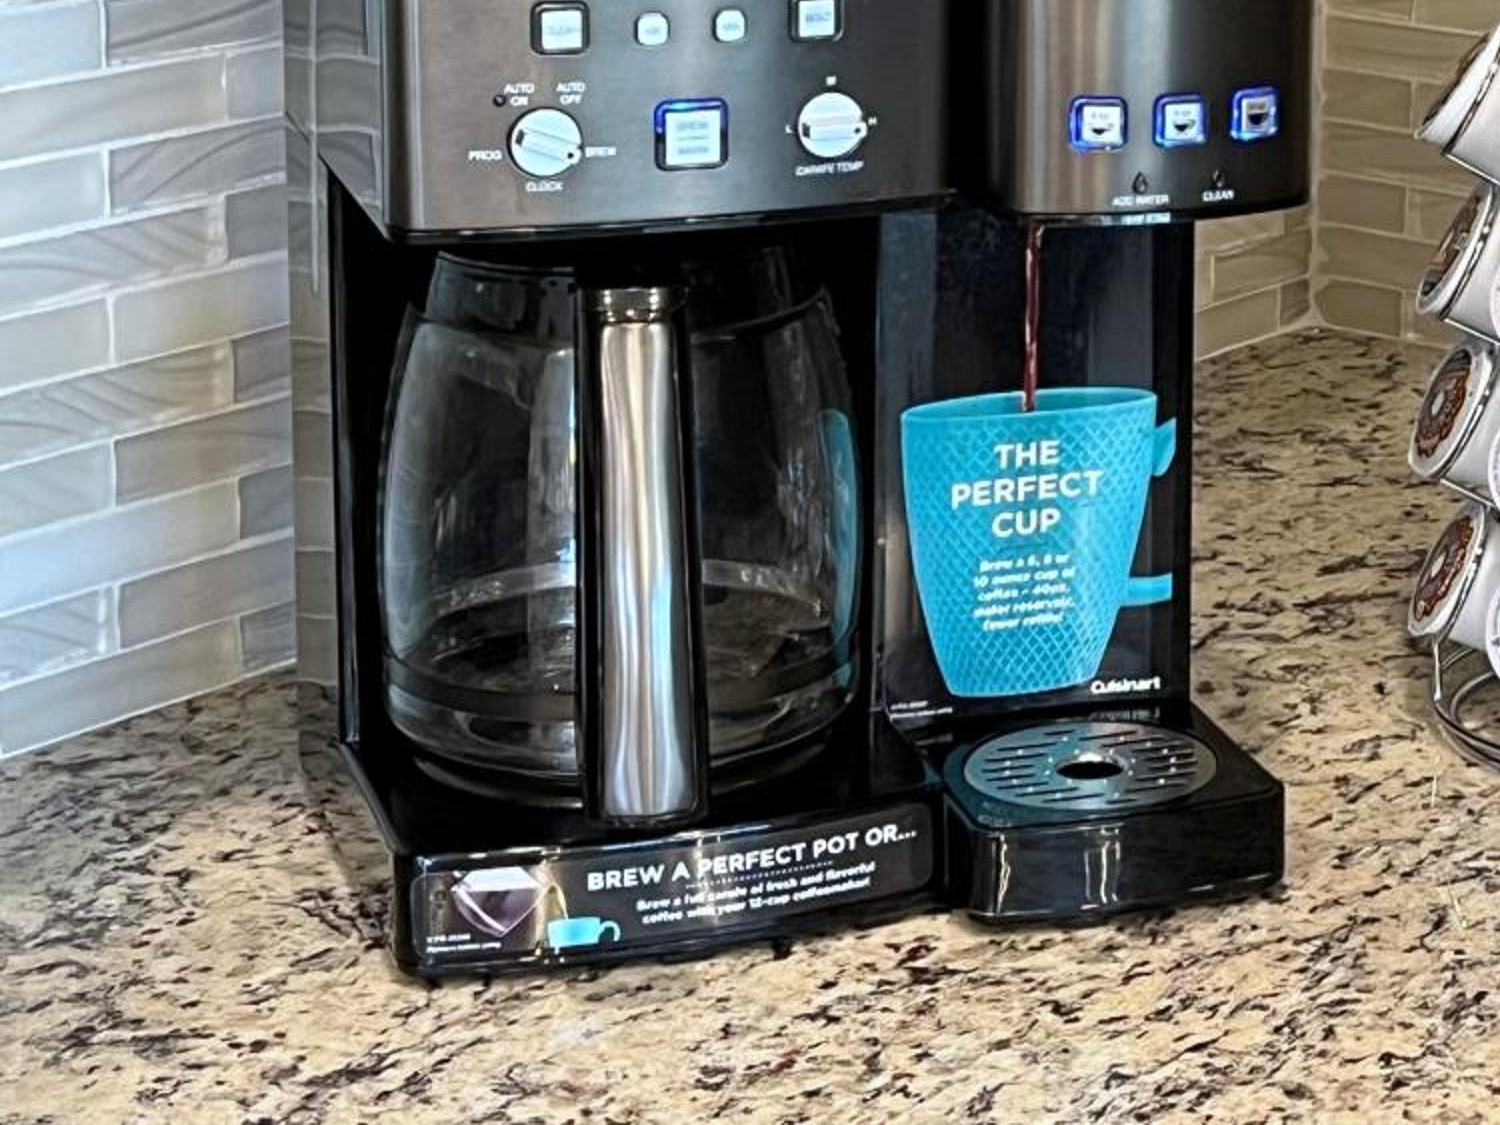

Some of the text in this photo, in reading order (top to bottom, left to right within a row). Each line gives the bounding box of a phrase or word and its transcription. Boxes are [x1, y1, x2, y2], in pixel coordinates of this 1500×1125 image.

[504, 83, 534, 94] AUTO
[556, 82, 586, 93] AUTO
[994, 440, 1062, 469] THE
[951, 470, 1105, 510] PERFECT
[992, 507, 1061, 538] CUP
[980, 559, 1013, 572] Brew
[1090, 675, 1161, 694] Cuisinart
[587, 824, 917, 892] BREW A PERFECT POT OR...
[636, 897, 671, 911] Brew
[750, 881, 764, 894] of
[766, 876, 798, 892] fresh
[800, 871, 824, 886] and
[642, 909, 683, 925] coffee
[716, 900, 747, 916] your
